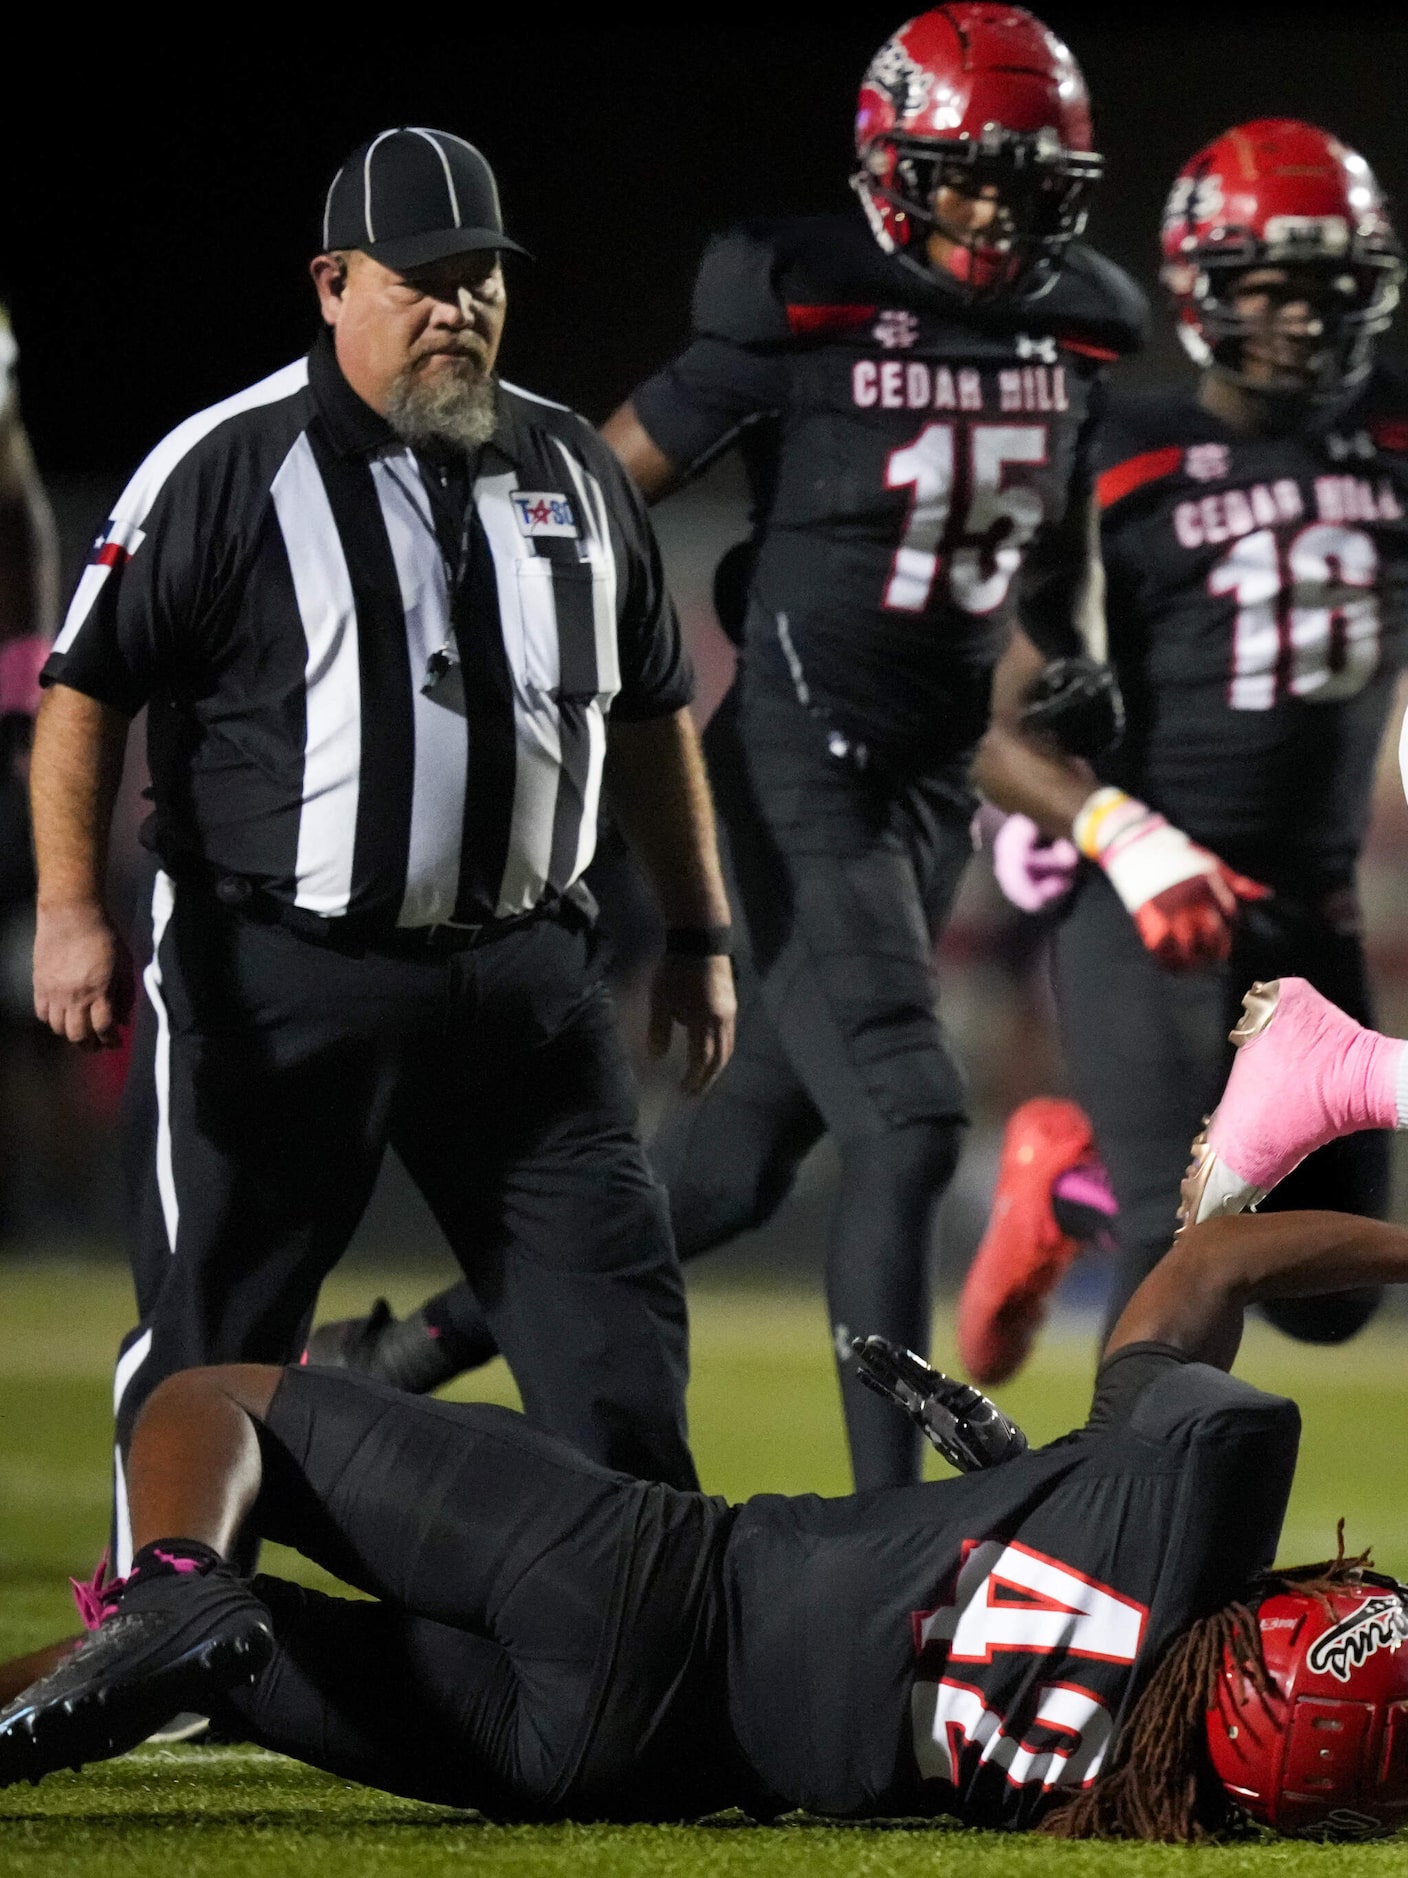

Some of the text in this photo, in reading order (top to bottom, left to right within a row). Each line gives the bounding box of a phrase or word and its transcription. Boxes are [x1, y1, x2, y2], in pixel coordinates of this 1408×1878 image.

[853, 360, 1069, 411] CEDAR HILL
[882, 418, 1048, 615] 15
[1173, 474, 1403, 548] CEDAR HILL
[1206, 518, 1383, 712] 16
[910, 1538, 1151, 1793] 42
